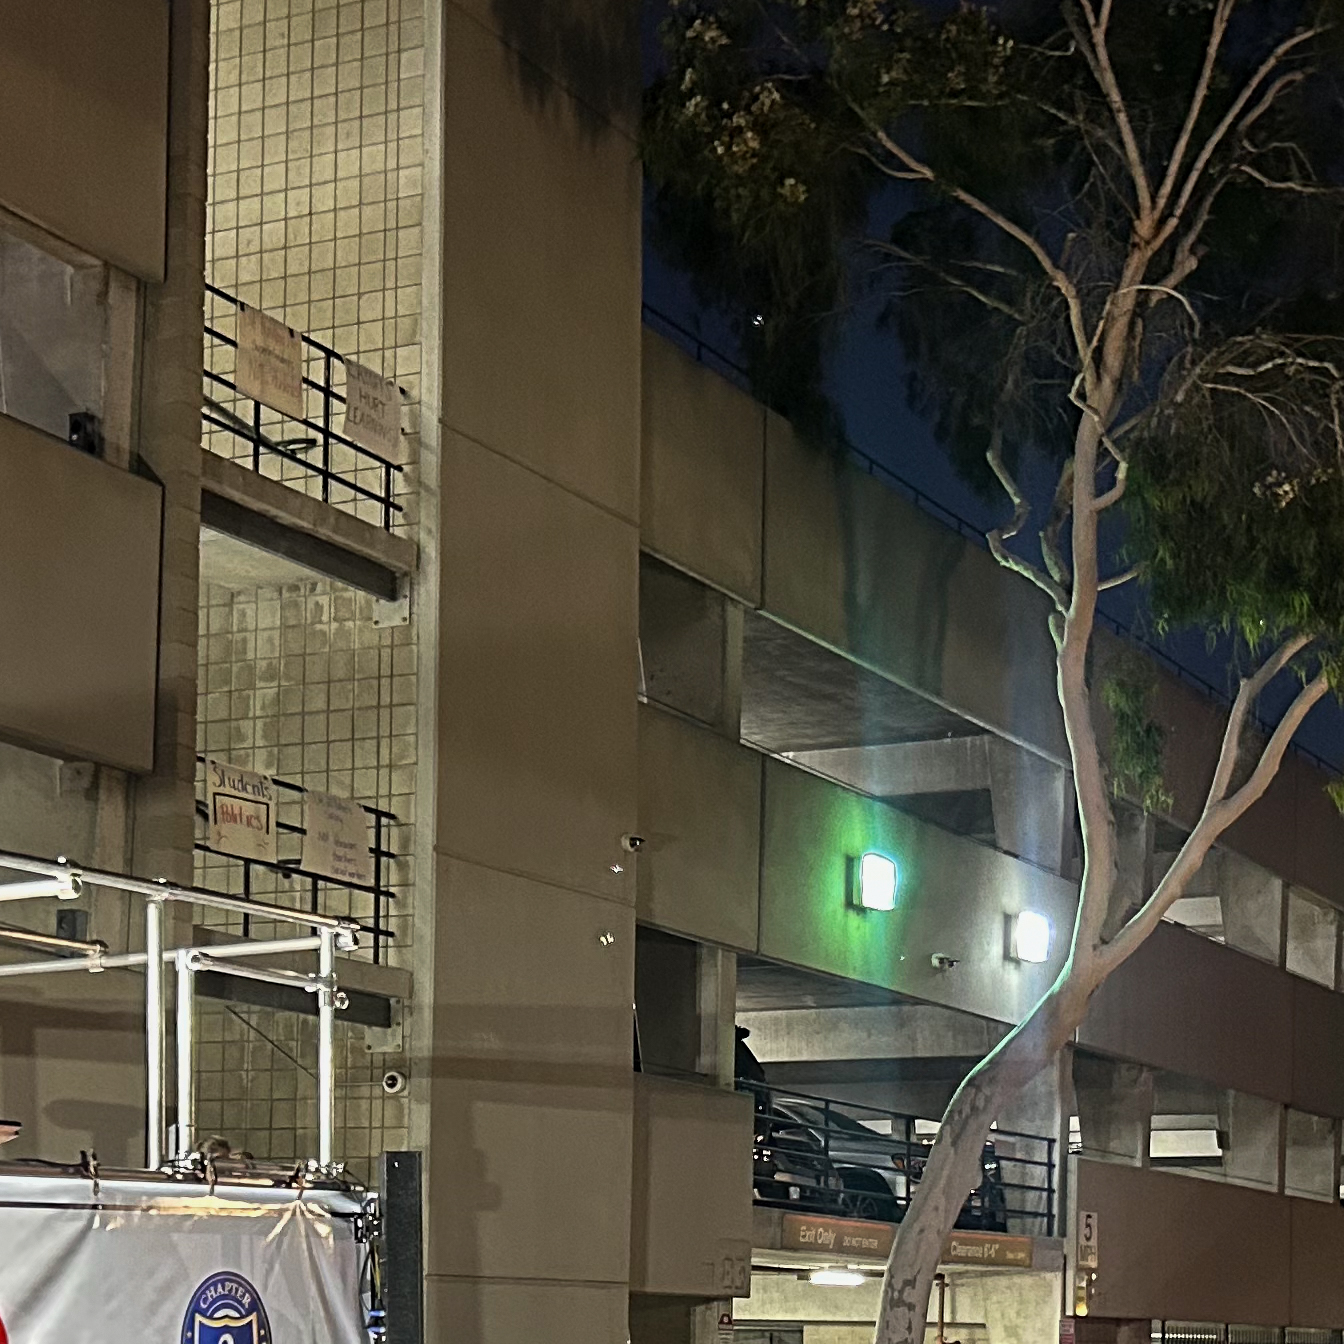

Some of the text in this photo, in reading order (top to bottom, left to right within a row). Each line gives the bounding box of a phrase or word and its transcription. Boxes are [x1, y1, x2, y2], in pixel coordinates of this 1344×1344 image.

[799, 1225, 816, 1244] Exit
[817, 1227, 837, 1249] Only
[1084, 1213, 1093, 1242] 5
[199, 1281, 252, 1309] CHAPTER
